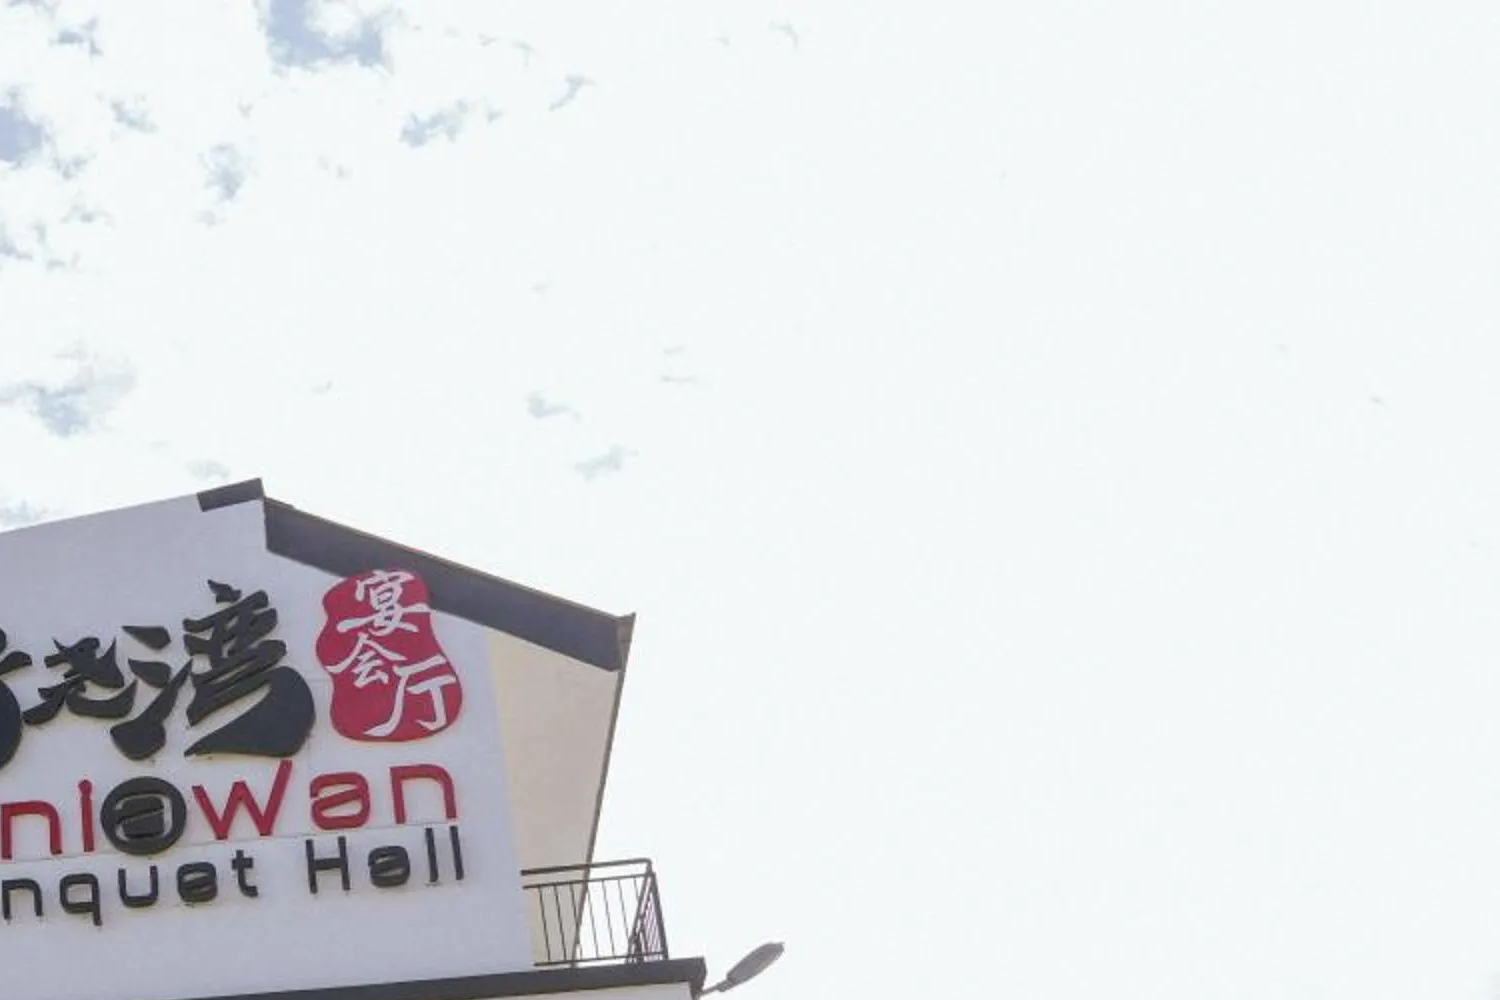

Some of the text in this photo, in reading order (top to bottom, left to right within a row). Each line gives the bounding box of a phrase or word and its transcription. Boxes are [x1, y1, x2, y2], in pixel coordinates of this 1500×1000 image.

[325, 569, 456, 737] 宴会厅
[306, 825, 465, 895] Hall
